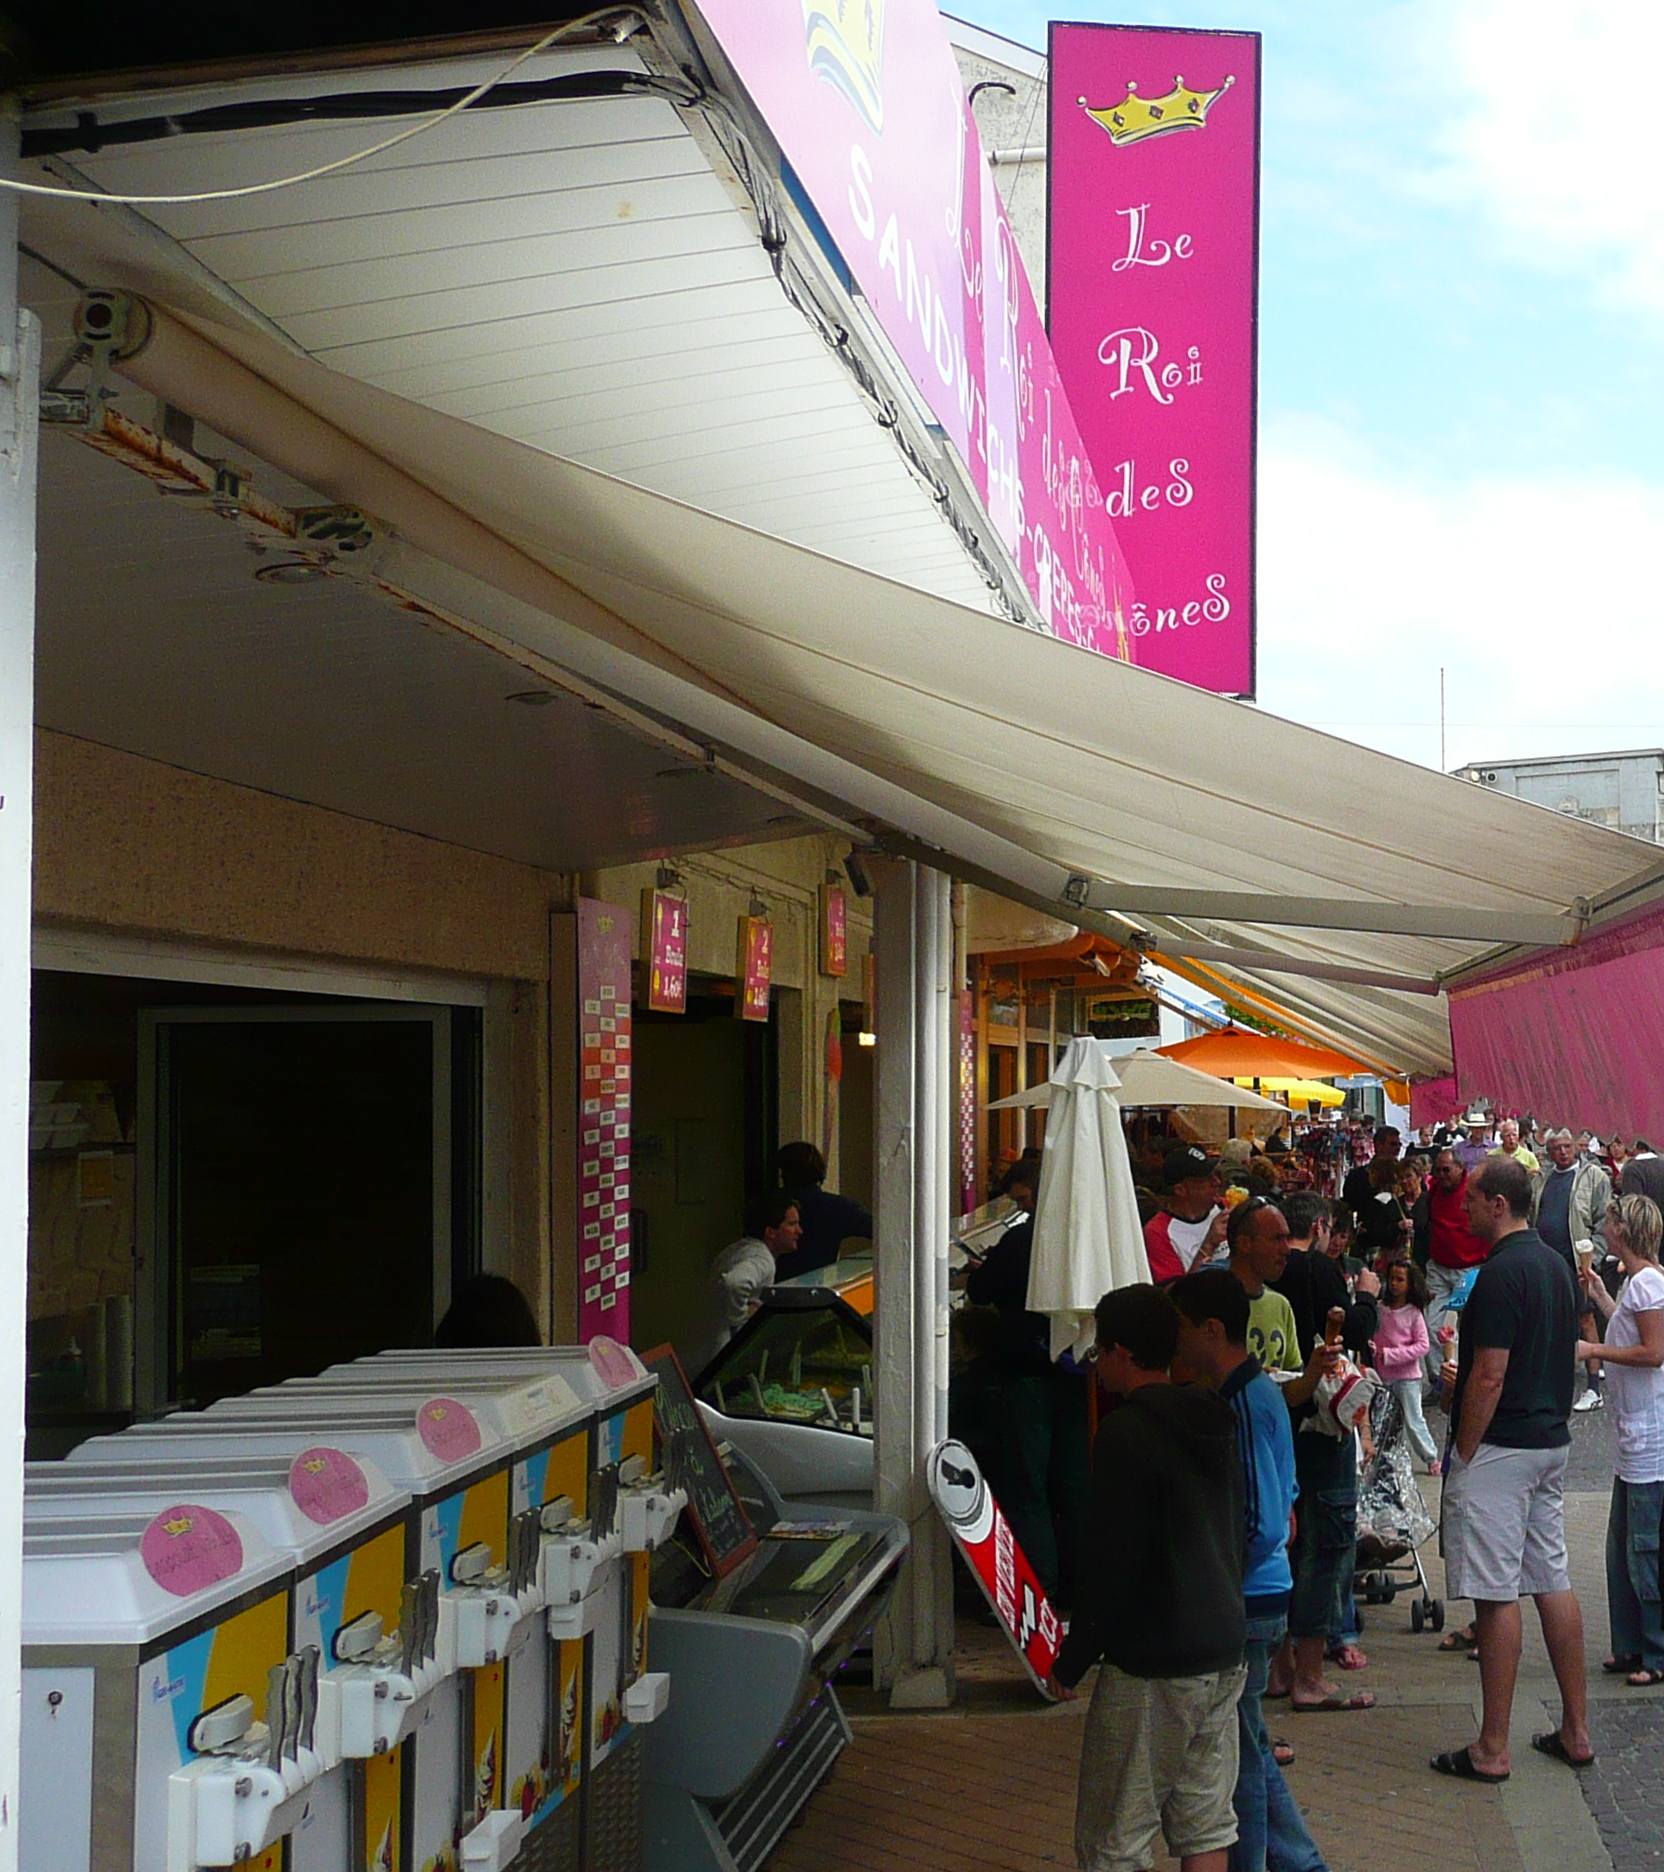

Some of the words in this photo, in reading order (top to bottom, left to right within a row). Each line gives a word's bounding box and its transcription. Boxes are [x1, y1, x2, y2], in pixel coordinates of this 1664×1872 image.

[1111, 202, 1194, 272] Le
[1098, 326, 1203, 404] Roi
[671, 910, 680, 938] 1
[761, 929, 769, 955] 2
